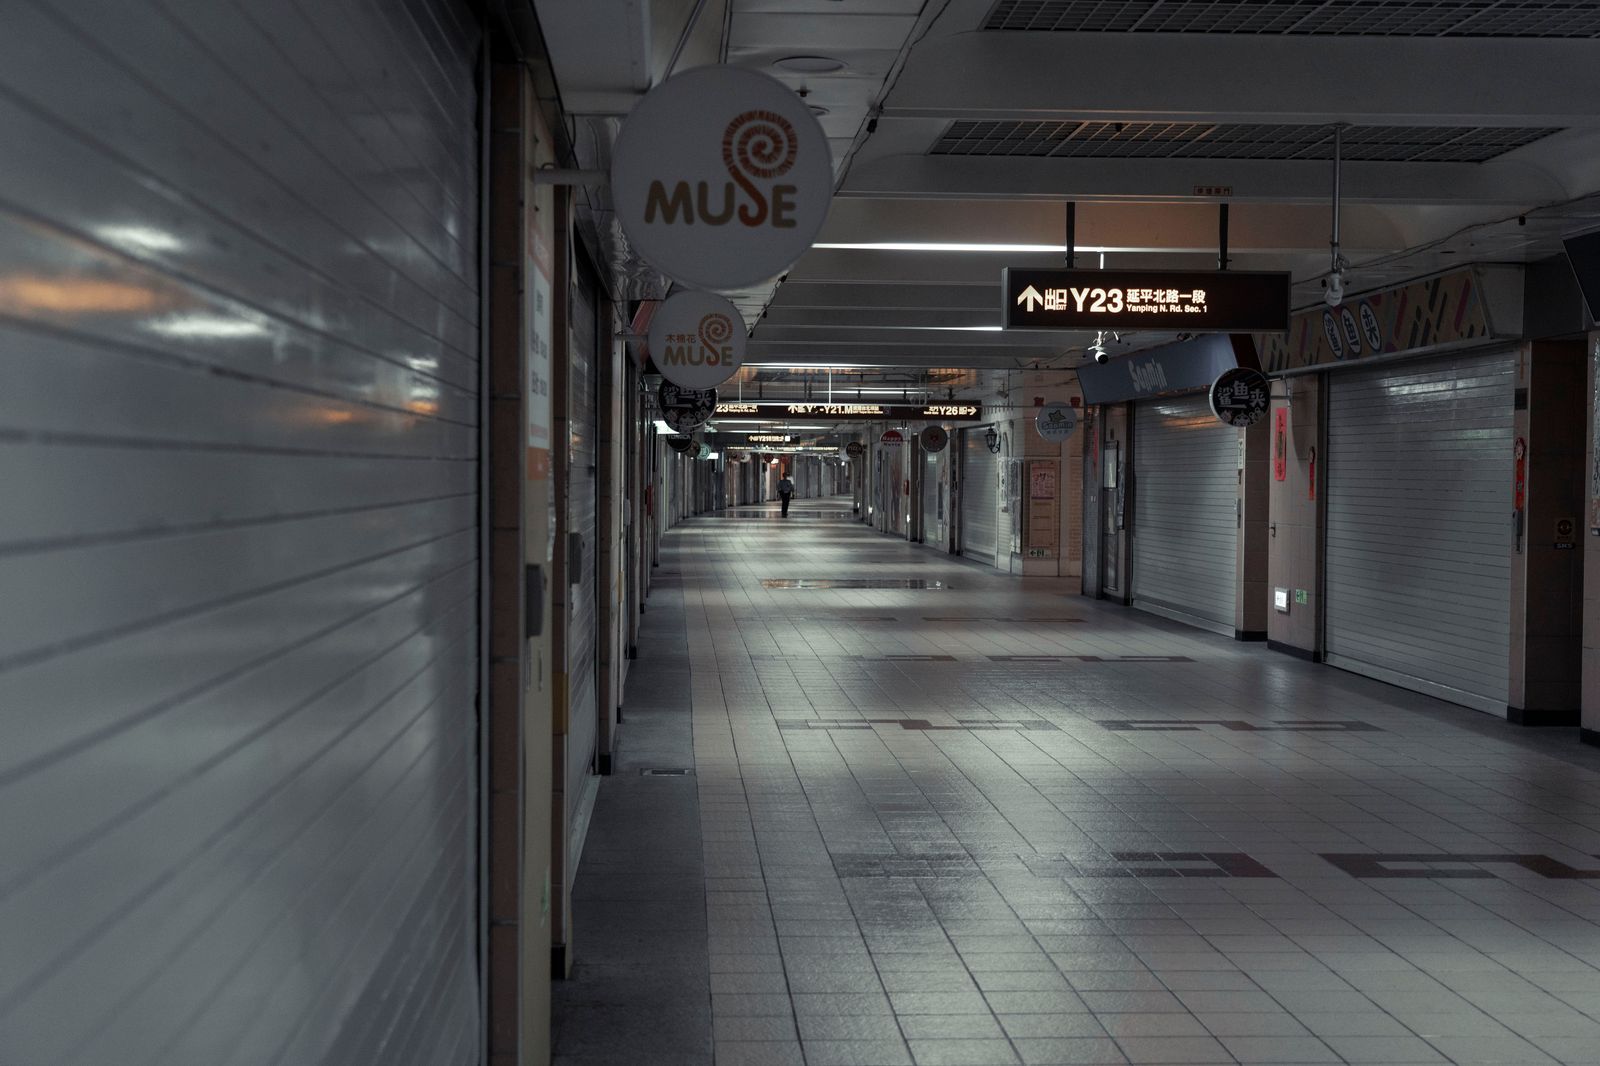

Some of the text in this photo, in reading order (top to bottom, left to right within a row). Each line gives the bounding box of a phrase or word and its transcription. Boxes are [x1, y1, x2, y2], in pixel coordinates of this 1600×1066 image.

[644, 164, 797, 228] MUSE
[1045, 288, 1123, 313] 出口 Y23
[1126, 288, 1206, 304] 延平北路一段
[1126, 303, 1158, 313] Yanping
[1159, 304, 1168, 312] N.
[1169, 304, 1183, 313] Rd.
[1184, 304, 1201, 313] Sec.
[663, 339, 733, 366] MUSE
[939, 406, 959, 415] Y26
